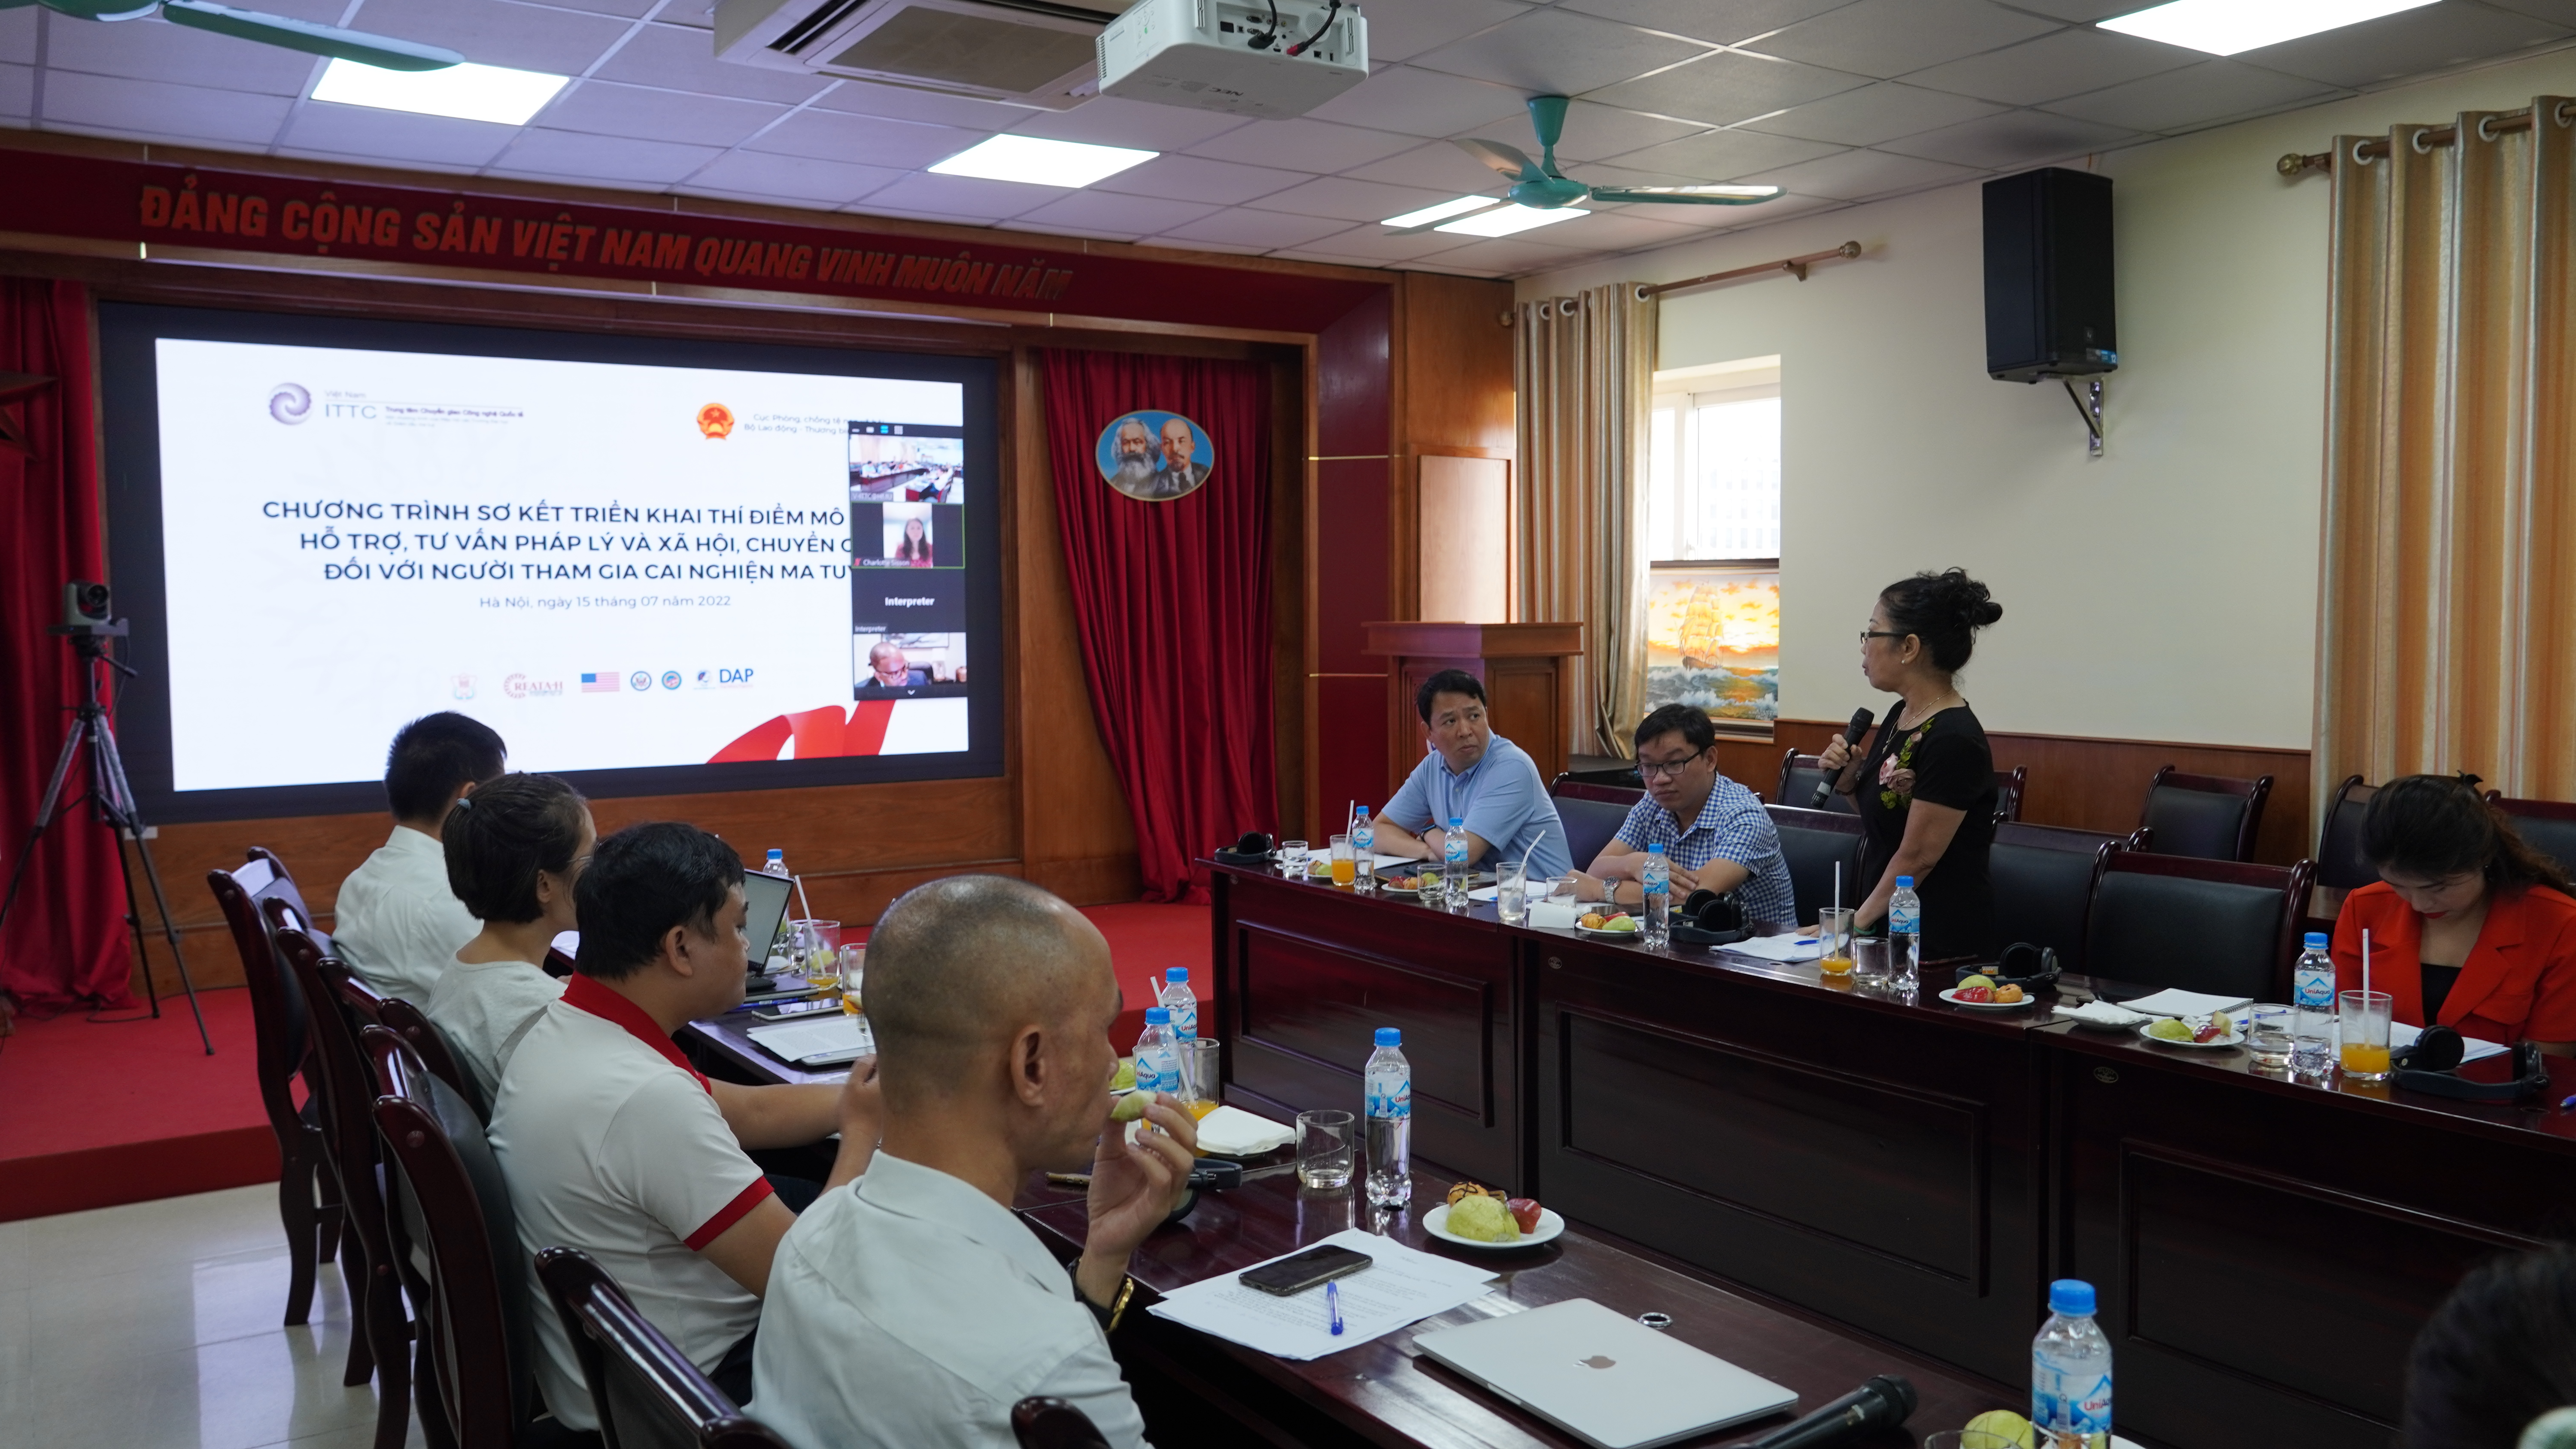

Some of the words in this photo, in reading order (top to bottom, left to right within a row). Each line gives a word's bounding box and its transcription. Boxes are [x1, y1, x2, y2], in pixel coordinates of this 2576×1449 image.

[140, 176, 269, 237] ĐẢNG
[282, 192, 401, 254] CỘNG
[412, 202, 502, 254] SẢN
[513, 215, 596, 271] VIỆT
[600, 229, 691, 270] NAM
[694, 237, 814, 281] QUANG
[817, 250, 896, 287] VINH
[892, 251, 994, 295] MUÔN
[990, 258, 1073, 300] NĂM
[326, 404, 377, 419] ITTC
[263, 500, 383, 519] CHƯƠNG
[391, 500, 469, 521] TRÌNH
[477, 503, 511, 521] SƠ
[519, 499, 564, 522] KẾT
[570, 500, 639, 523] TRIỂN
[647, 508, 701, 524] KHAI
[708, 506, 743, 524] THÍ
[750, 503, 803, 525] ĐIỂM
[811, 507, 844, 526] MÔ
[300, 526, 340, 550] HỖ
[346, 531, 408, 555] TRỢ,
[414, 532, 449, 551] TƯ
[455, 528, 507, 551] VẤN
[515, 532, 581, 551] PHÁP
[589, 532, 614, 551] LÝ
[621, 532, 652, 552] VÀ
[658, 533, 689, 552] XÃ
[696, 533, 740, 557] HỘI,
[746, 530, 834, 552] CHUYỂN
[324, 557, 371, 580] ĐỐI
[378, 560, 423, 580] VỚI
[432, 560, 514, 580] NGƯỜI
[521, 564, 591, 579] THAM
[598, 564, 638, 579] GIA
[644, 564, 681, 579] CAI
[690, 561, 774, 584] NGHIỆN
[781, 565, 814, 579] MA
[480, 597, 500, 608] Hà
[505, 597, 533, 609] Nội,
[538, 598, 572, 610] ngày
[577, 597, 590, 607] 15
[595, 597, 636, 609] tháng
[641, 596, 658, 606] 07
[663, 596, 693, 606] năm
[699, 596, 731, 606] 2022
[885, 597, 935, 608] Interpreter
[720, 668, 753, 683] DAP
